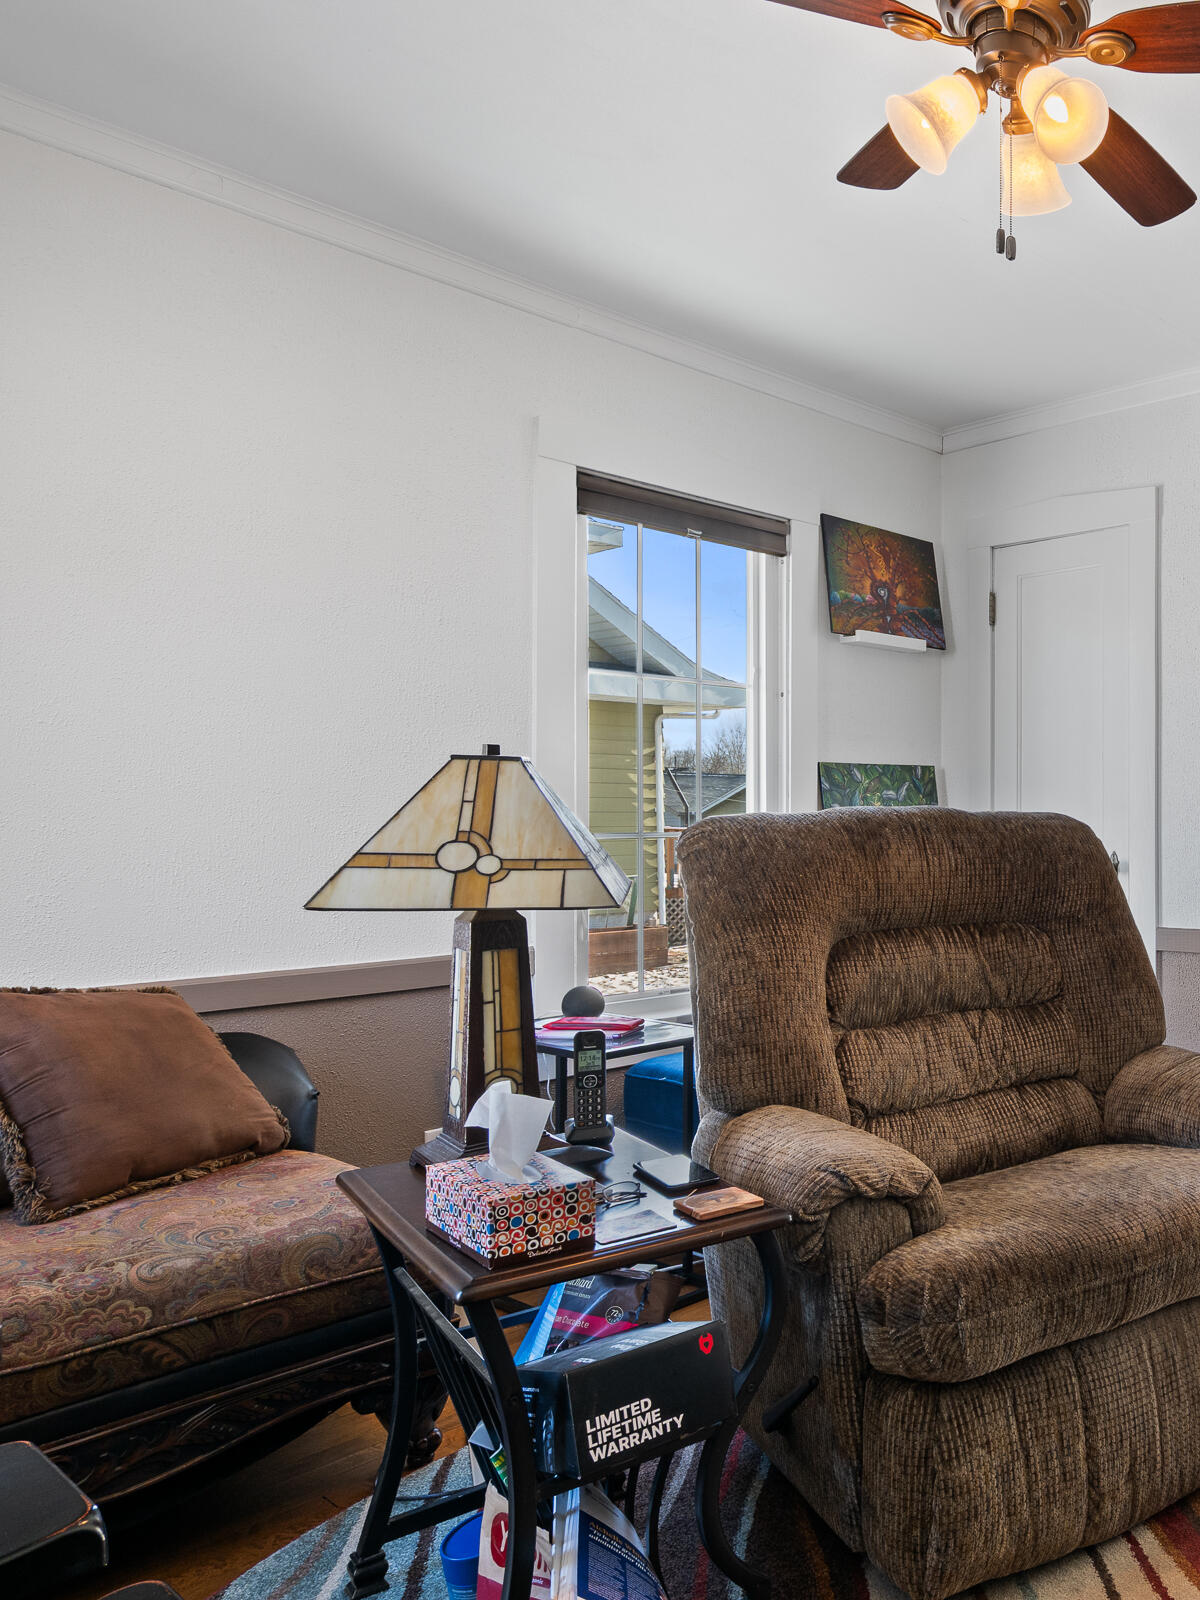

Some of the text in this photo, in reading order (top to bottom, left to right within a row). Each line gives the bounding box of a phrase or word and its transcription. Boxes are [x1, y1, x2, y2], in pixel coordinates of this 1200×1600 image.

[585, 1397, 652, 1434] LIMITED
[587, 1407, 662, 1449] LIFETIME
[589, 1413, 684, 1463] WARRANTY
